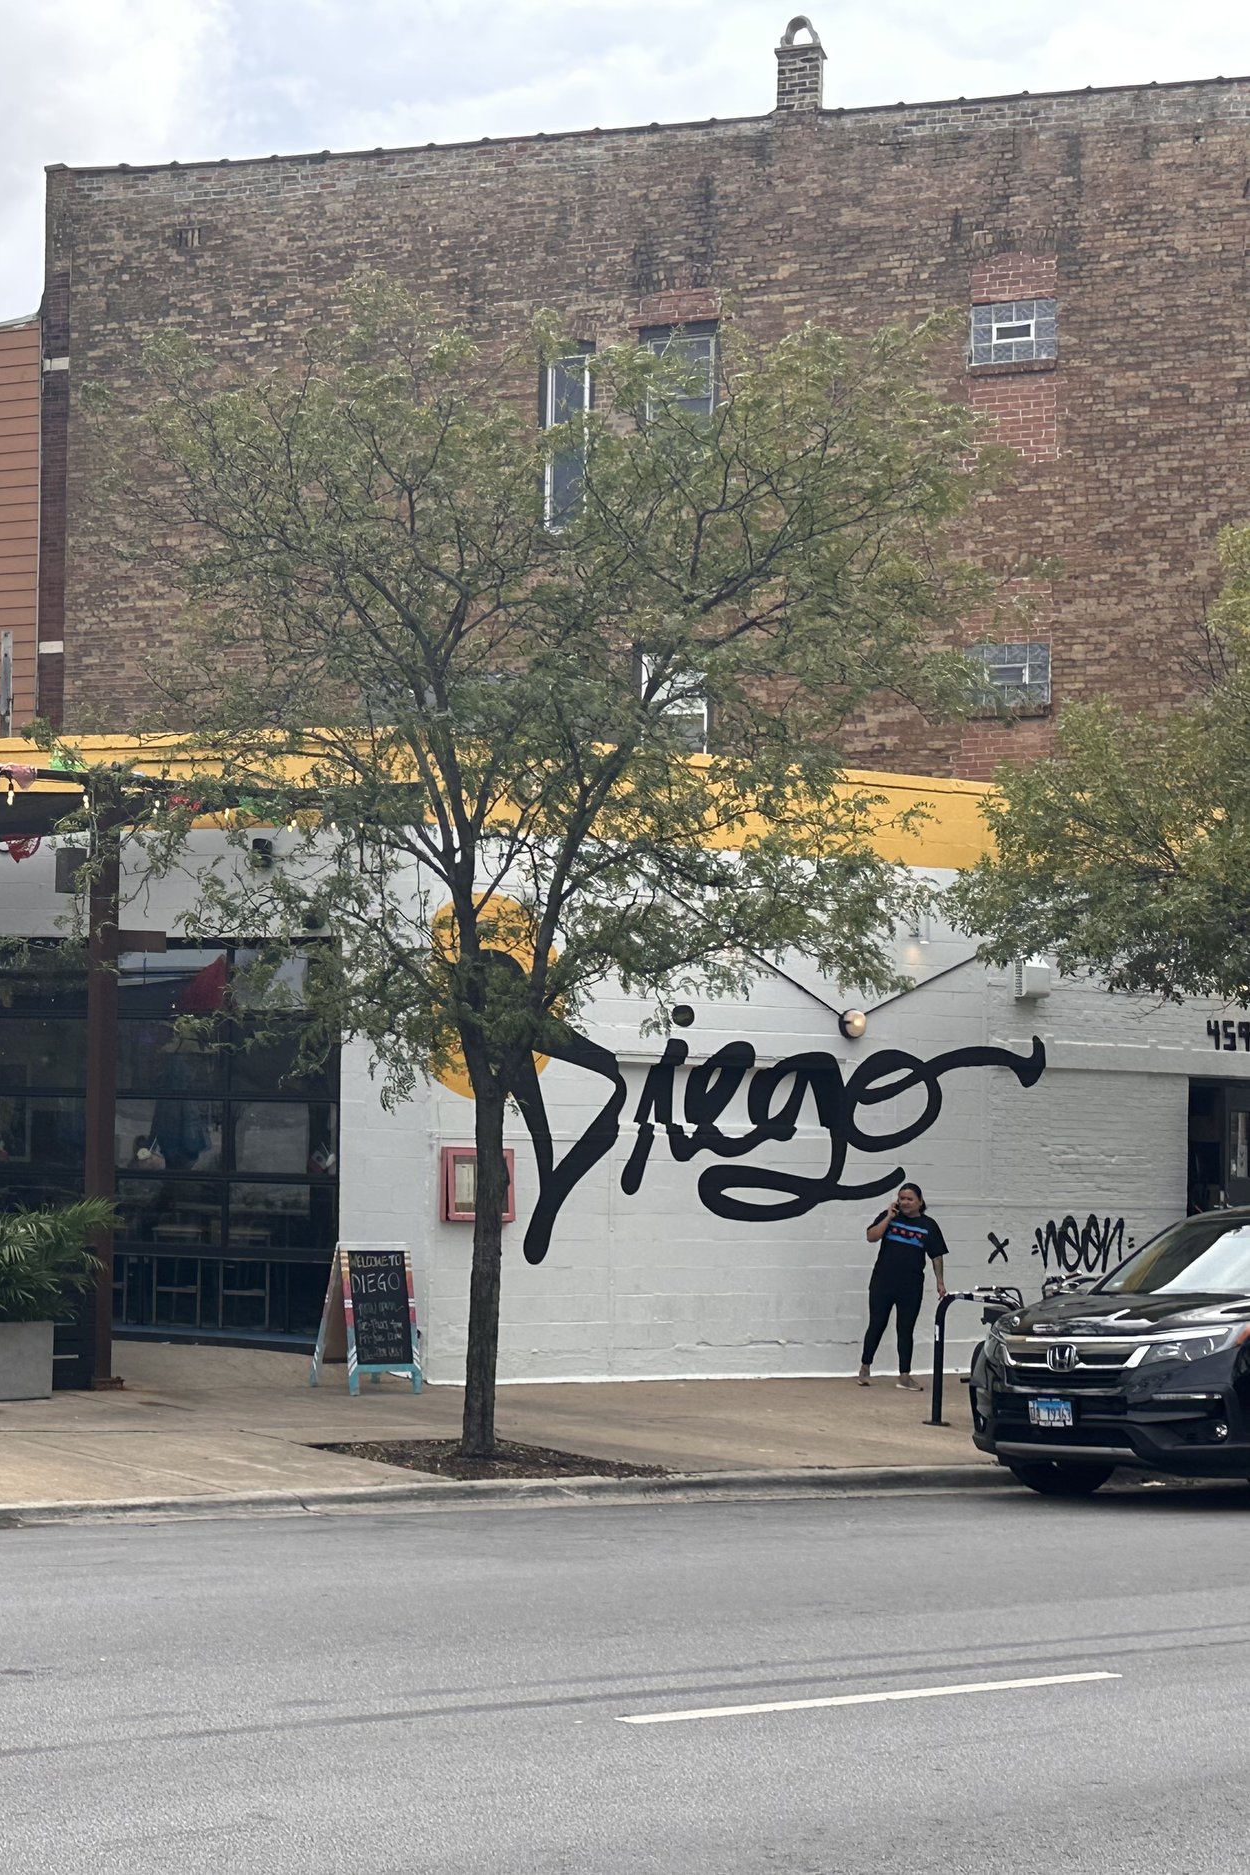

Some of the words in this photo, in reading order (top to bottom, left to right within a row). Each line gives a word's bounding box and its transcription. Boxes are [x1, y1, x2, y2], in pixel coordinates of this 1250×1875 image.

[1206, 1020, 1250, 1052] 459
[483, 948, 1047, 1266] Diego
[388, 1254, 402, 1266] TO
[351, 1272, 400, 1294] DIEGO
